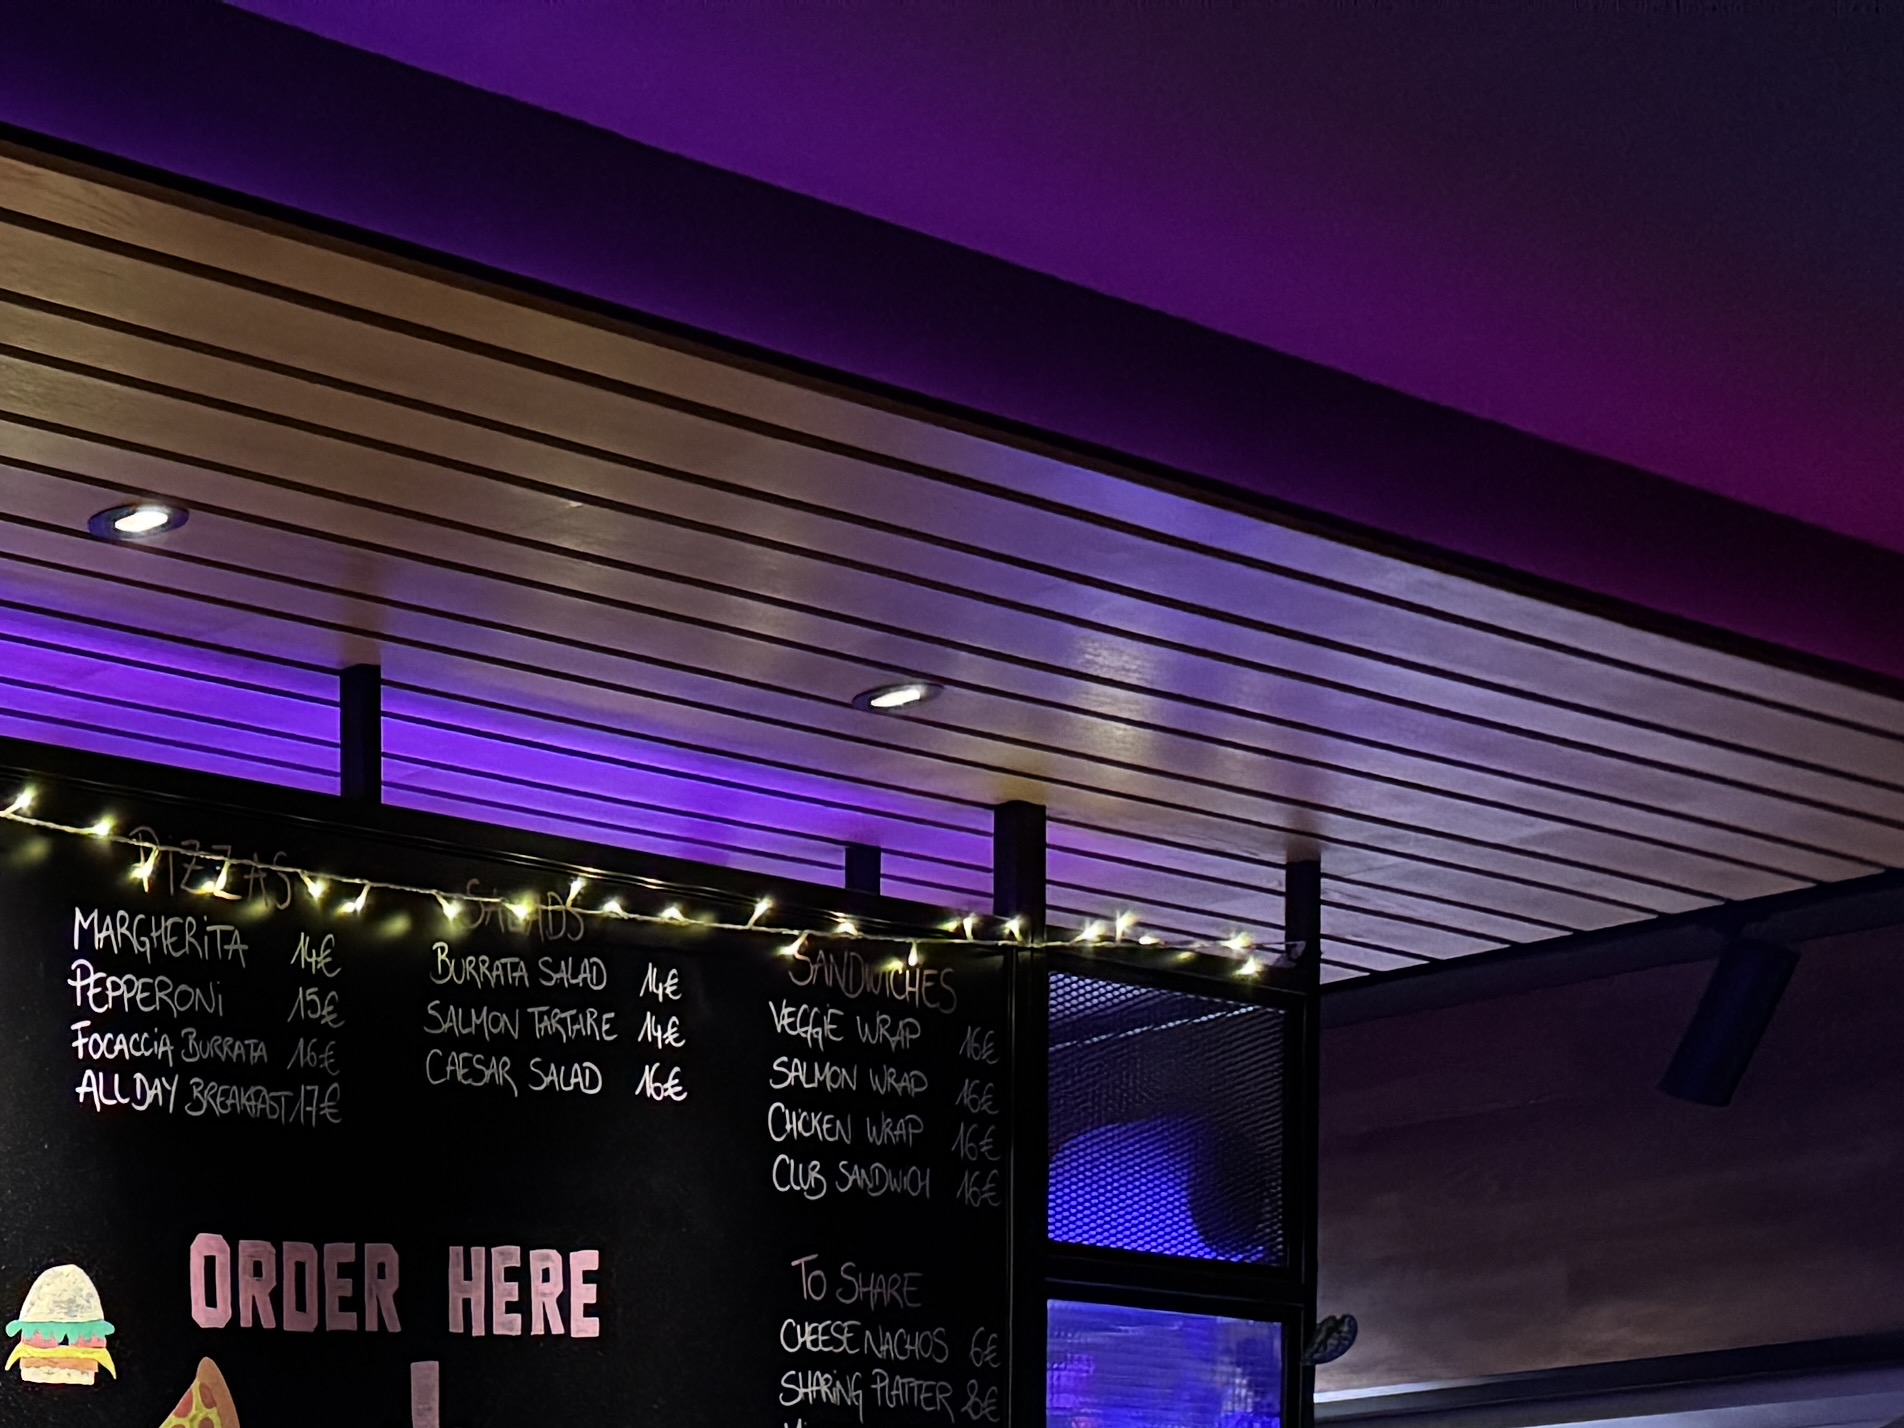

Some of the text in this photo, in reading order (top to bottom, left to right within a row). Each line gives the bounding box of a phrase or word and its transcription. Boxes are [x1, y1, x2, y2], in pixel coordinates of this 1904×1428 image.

[464, 878, 585, 943] SAADS
[72, 907, 342, 978] MARGHERITA 14€
[68, 958, 345, 1028] PEPPERONI 15€
[429, 941, 683, 1001] BURRATA SALAD 14€
[180, 1026, 268, 1064] BURRATA
[286, 1037, 341, 1076] 16€
[423, 1000, 688, 1051] SALMON TARTARE 14€
[856, 1010, 922, 1053] WRAP
[959, 1025, 1000, 1065] 16€
[426, 1049, 689, 1102] CAESAR SALAD 16€
[769, 1056, 1001, 1115] SALMON WRAP 16€
[289, 1083, 343, 1127] 17€
[866, 1111, 924, 1148] WRAP
[951, 1121, 1001, 1161] 16€
[772, 1153, 827, 1201] CLUB
[956, 1168, 1002, 1208] 16€
[190, 1233, 600, 1338] ORDER HERE
[791, 1253, 923, 1312] TO SHARE
[780, 1318, 1001, 1368] CHEESE NACHOS 6€
[870, 1368, 955, 1424] PLATTER
